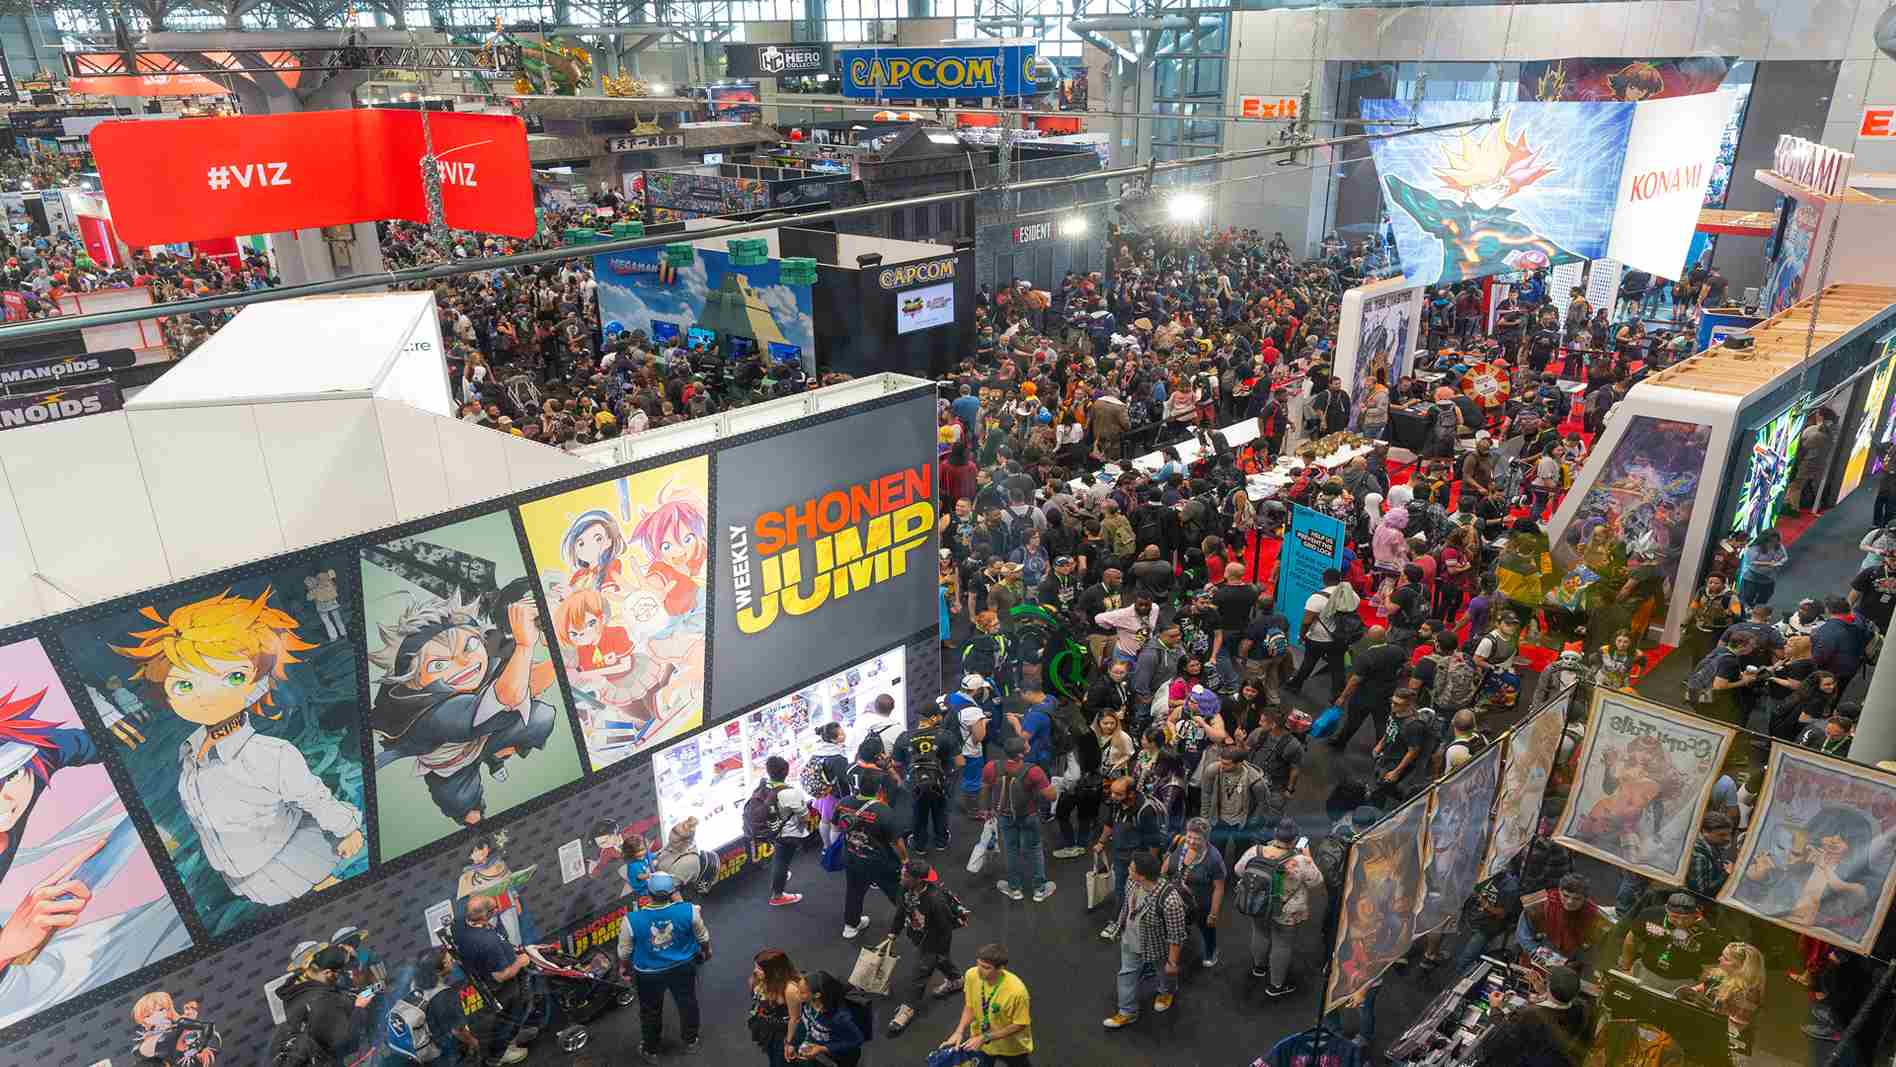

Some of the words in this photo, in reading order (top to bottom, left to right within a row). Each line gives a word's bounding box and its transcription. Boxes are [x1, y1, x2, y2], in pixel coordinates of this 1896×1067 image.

[784, 52, 820, 63] HERO
[851, 56, 997, 89] CAPCOM
[1242, 98, 1297, 118] Exit
[1860, 110, 1896, 136] E
[207, 162, 292, 190] #VIZ
[1775, 135, 1849, 196] KONAMI
[1630, 162, 1703, 202] KONAMI
[1011, 222, 1051, 243] RESIDENT
[879, 258, 956, 289] CAPCOM
[754, 463, 931, 556] SHONEN
[729, 525, 752, 610] WEEKLY
[736, 501, 935, 634] JUMP
